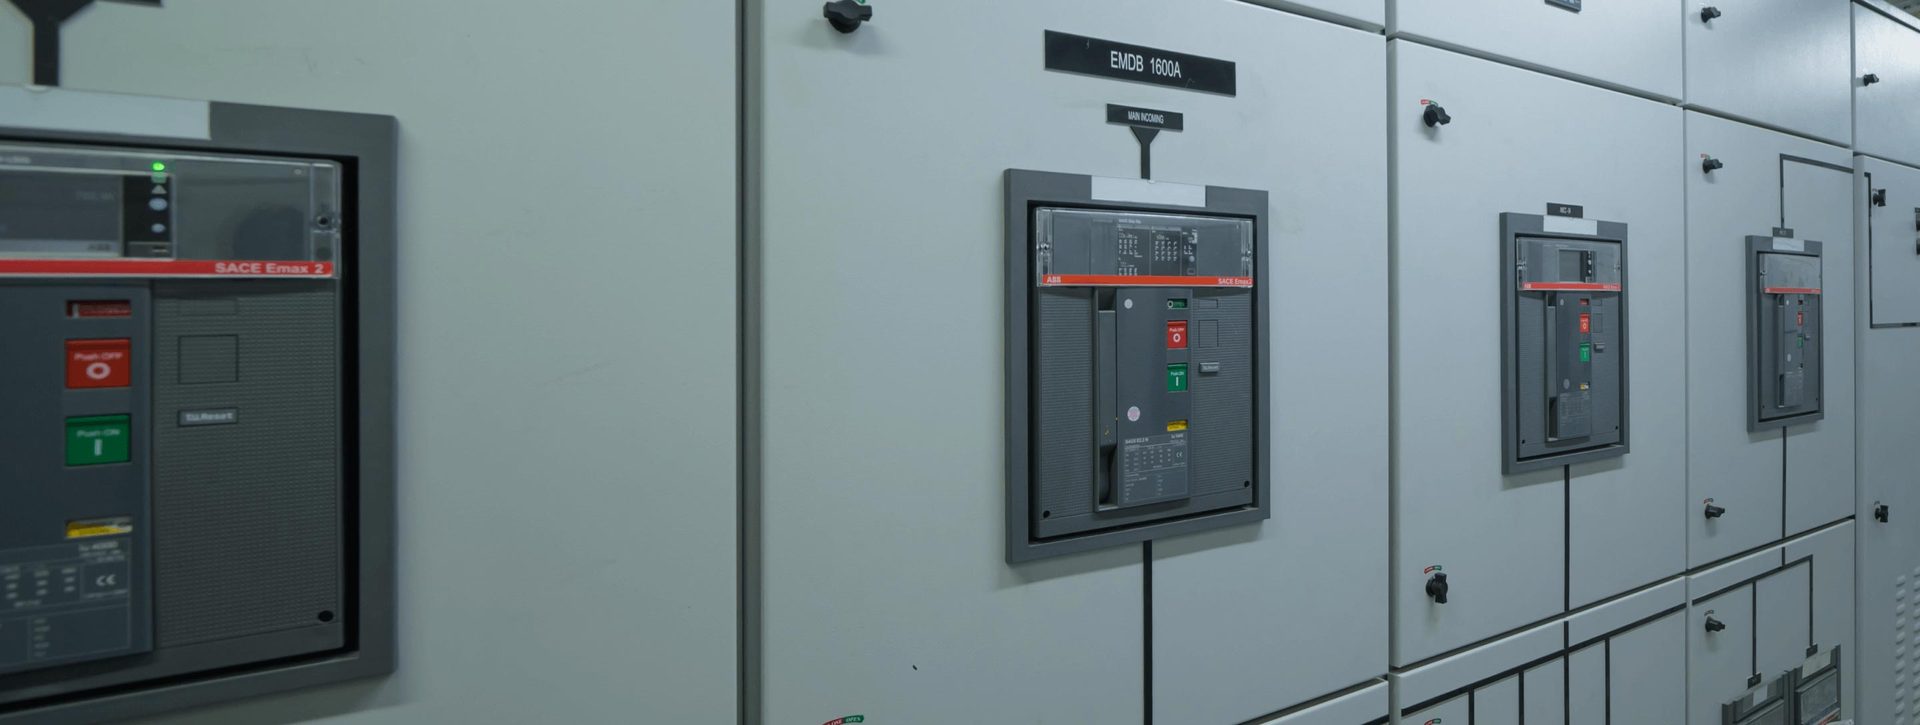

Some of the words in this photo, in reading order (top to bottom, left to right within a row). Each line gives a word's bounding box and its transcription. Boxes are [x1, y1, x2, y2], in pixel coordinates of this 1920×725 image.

[1110, 50, 1144, 72] EMDB
[1150, 57, 1182, 79] 1600A
[1128, 110, 1140, 121] MAIN
[1141, 112, 1164, 124] INCOMING
[215, 262, 262, 274] SACE
[265, 262, 309, 274] Emax
[314, 262, 324, 274] 2
[1046, 275, 1061, 283] ABB
